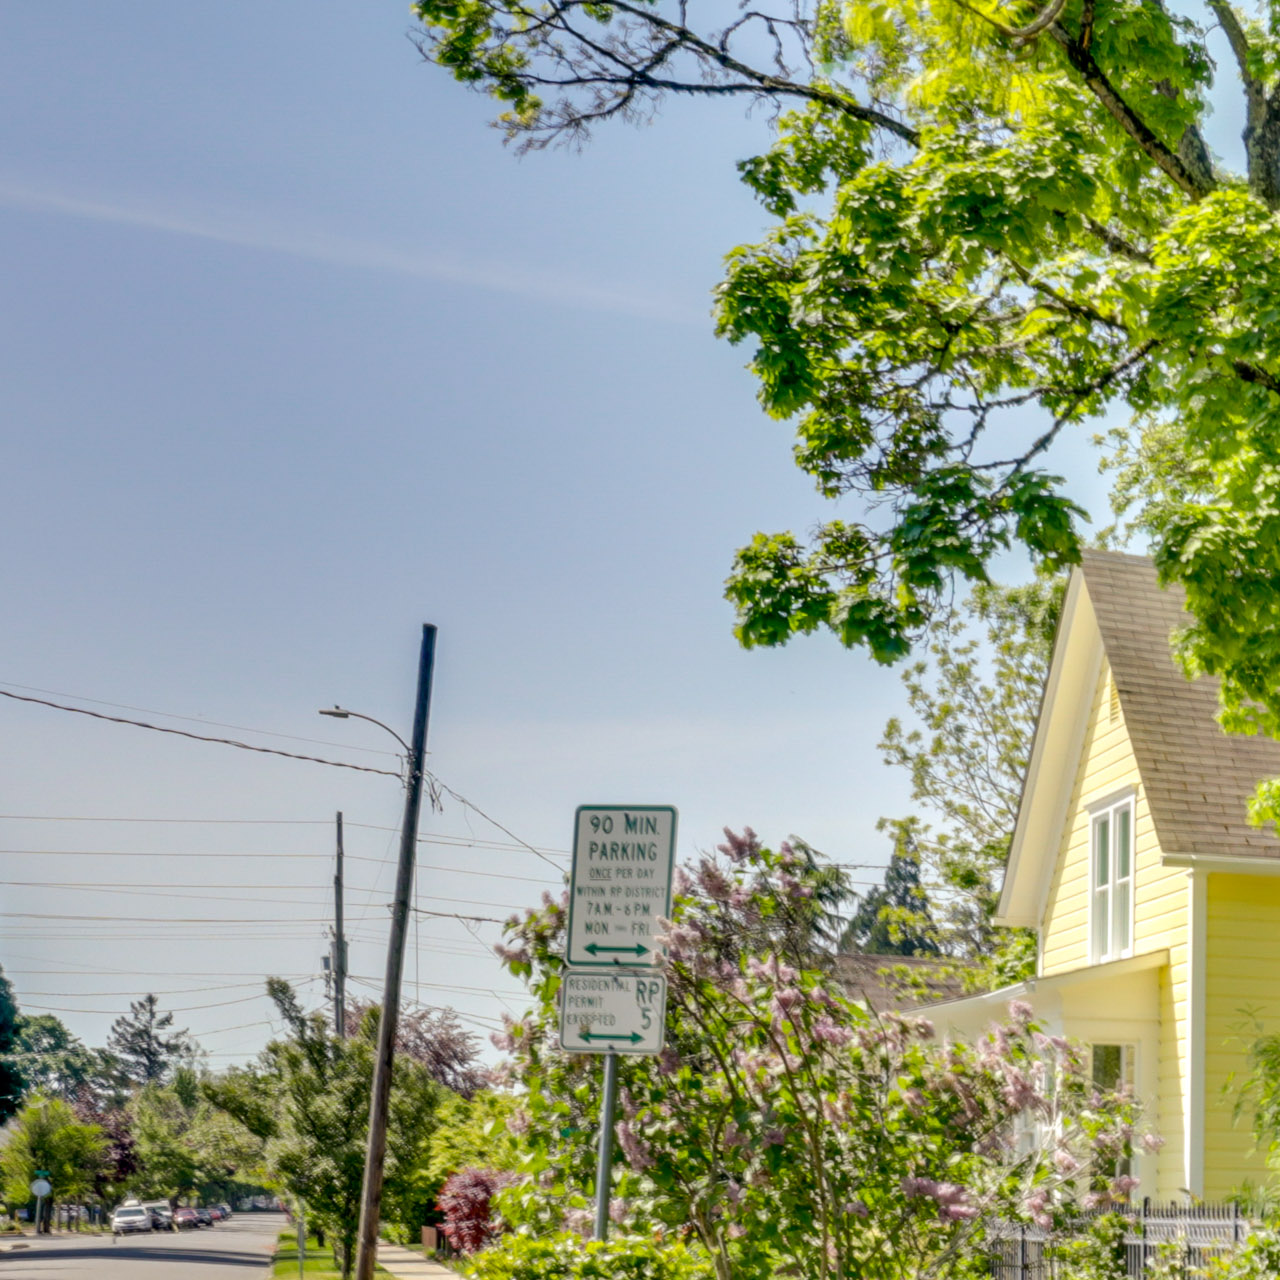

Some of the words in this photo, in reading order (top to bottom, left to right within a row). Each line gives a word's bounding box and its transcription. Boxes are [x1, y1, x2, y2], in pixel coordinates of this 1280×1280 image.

[590, 815, 613, 834] 90
[624, 815, 660, 835] MIN.
[589, 842, 657, 861] PARKING
[589, 868, 612, 879] ONCE
[615, 868, 633, 879] PER
[637, 868, 655, 879] DAY
[577, 886, 605, 898] WITHIN
[625, 887, 665, 898] DISTRICT
[568, 977, 632, 993] RESIDENTIAL
[636, 980, 660, 1005] RP
[568, 995, 604, 1009] PERMIT
[641, 1009, 651, 1030] 5
